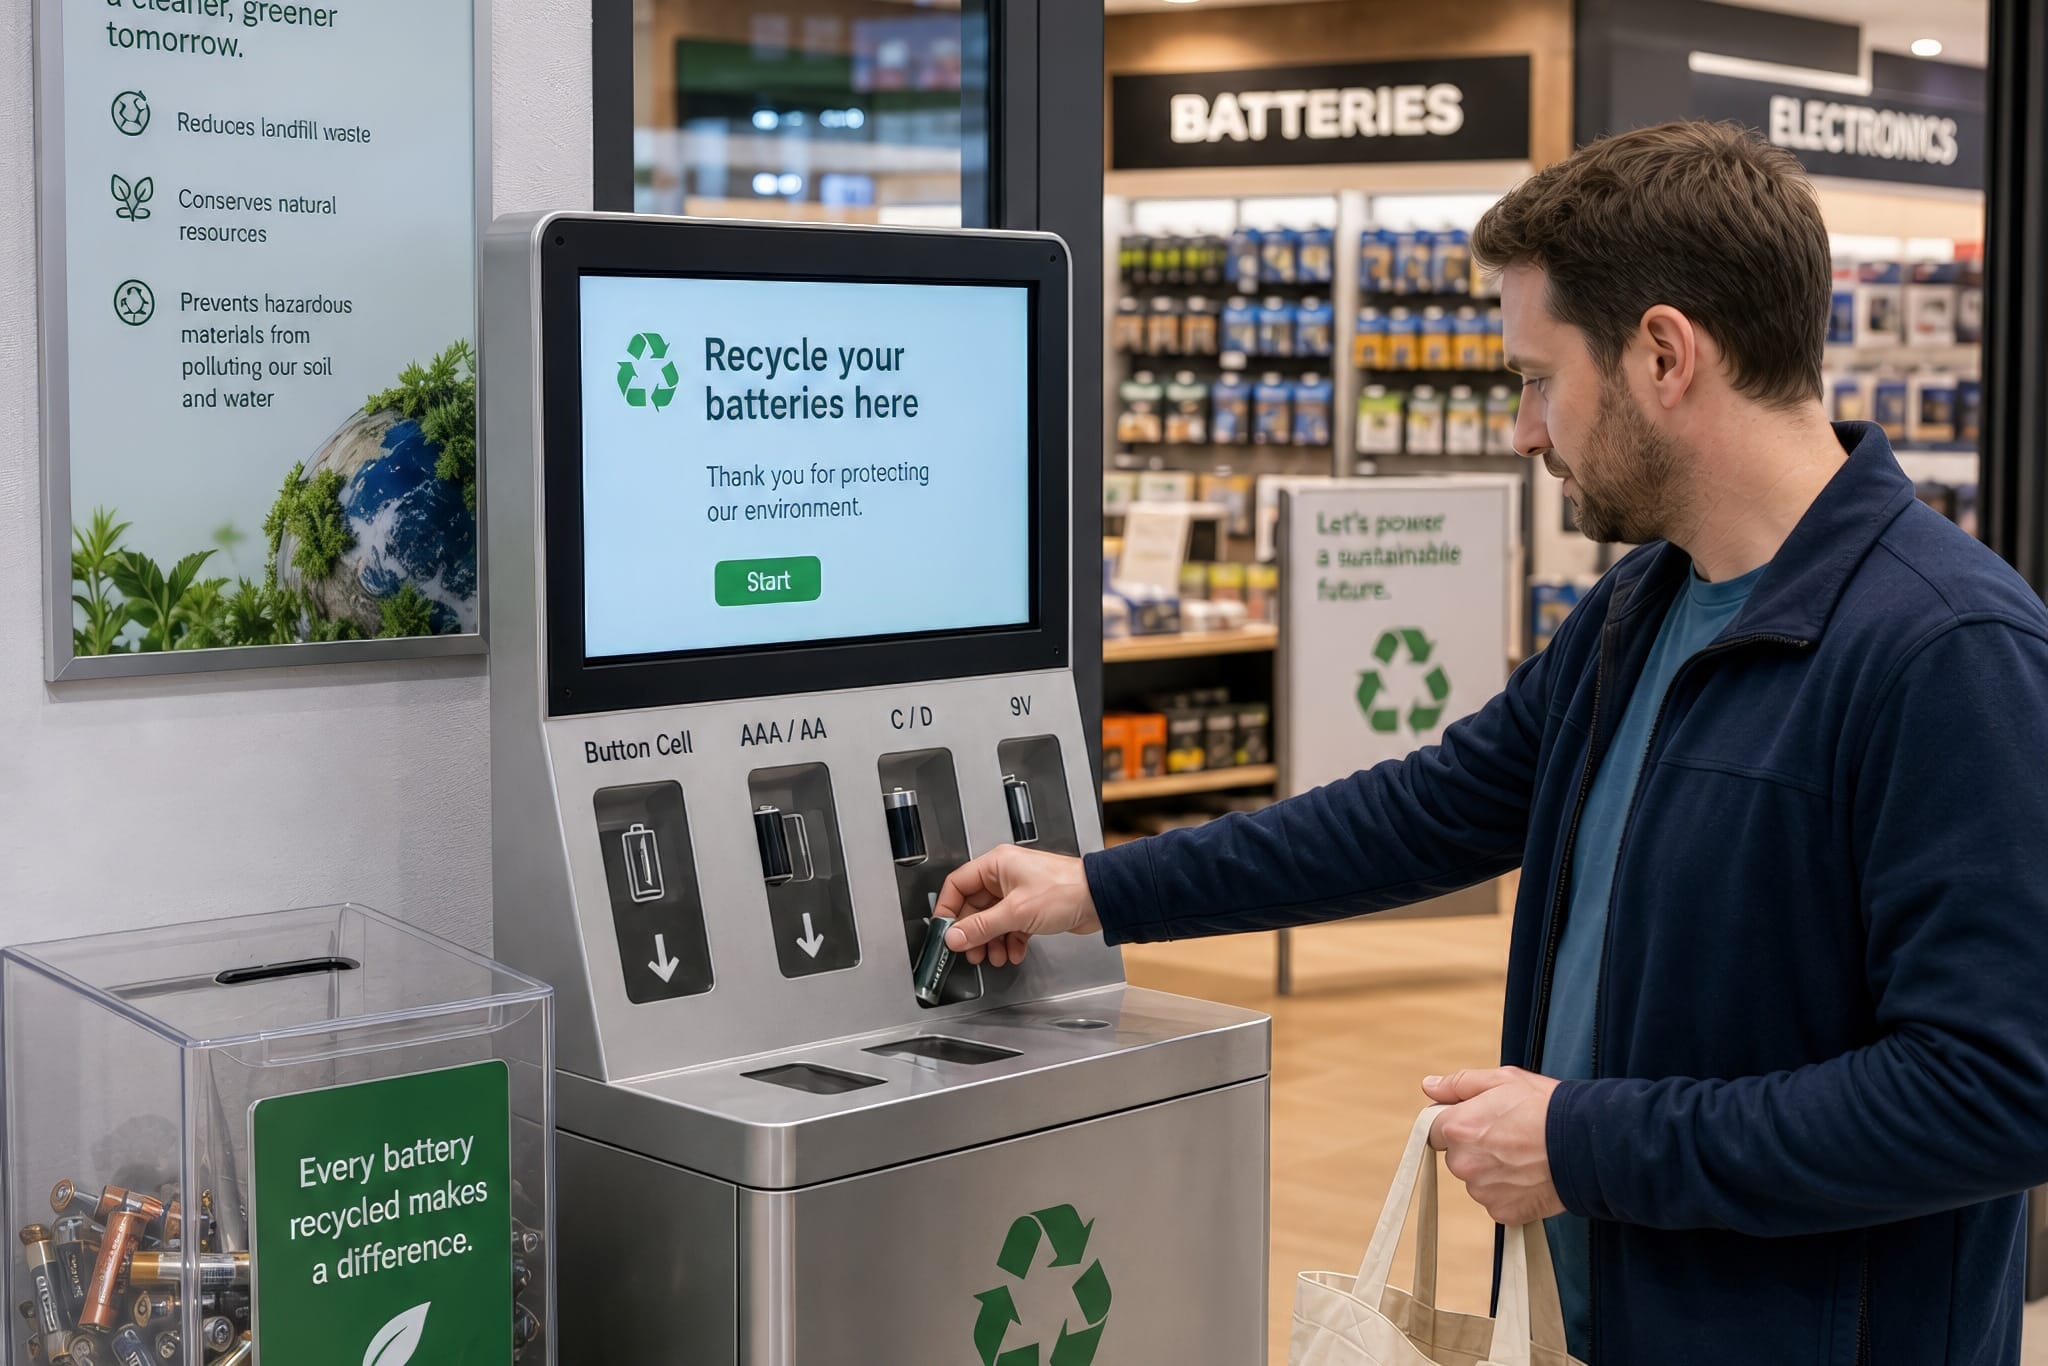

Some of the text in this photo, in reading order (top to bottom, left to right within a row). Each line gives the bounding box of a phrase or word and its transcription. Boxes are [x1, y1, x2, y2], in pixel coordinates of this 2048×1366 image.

[243, 1, 338, 27] greener
[106, 21, 243, 57] tomorrow.
[1170, 83, 1464, 143] BATTERIES
[178, 112, 371, 143] Reduces landfill waste
[1769, 95, 1958, 165] ELECTRONICS
[179, 189, 337, 214] Conserves natural
[180, 226, 267, 243] resources
[181, 292, 353, 314] Prevents hazardous
[182, 324, 310, 344] materials from
[182, 355, 333, 381] polluting our soil
[705, 337, 905, 380] Recycle your
[182, 388, 274, 407] and water
[706, 385, 919, 421] batteries here
[706, 462, 929, 491] Thank you for protecting
[707, 498, 863, 522] our environment.
[1316, 510, 1445, 538] Let's power
[1316, 550, 1329, 567] a
[747, 570, 791, 592] Start
[891, 709, 904, 730] C
[920, 706, 933, 727] D
[1010, 695, 1031, 716] 9V
[740, 721, 783, 747] AAA
[800, 717, 827, 741] AA
[584, 730, 693, 764] Button Cell
[300, 1135, 474, 1188] Every battery
[290, 1179, 488, 1240] recycled makes
[312, 1232, 473, 1285] a difference.
